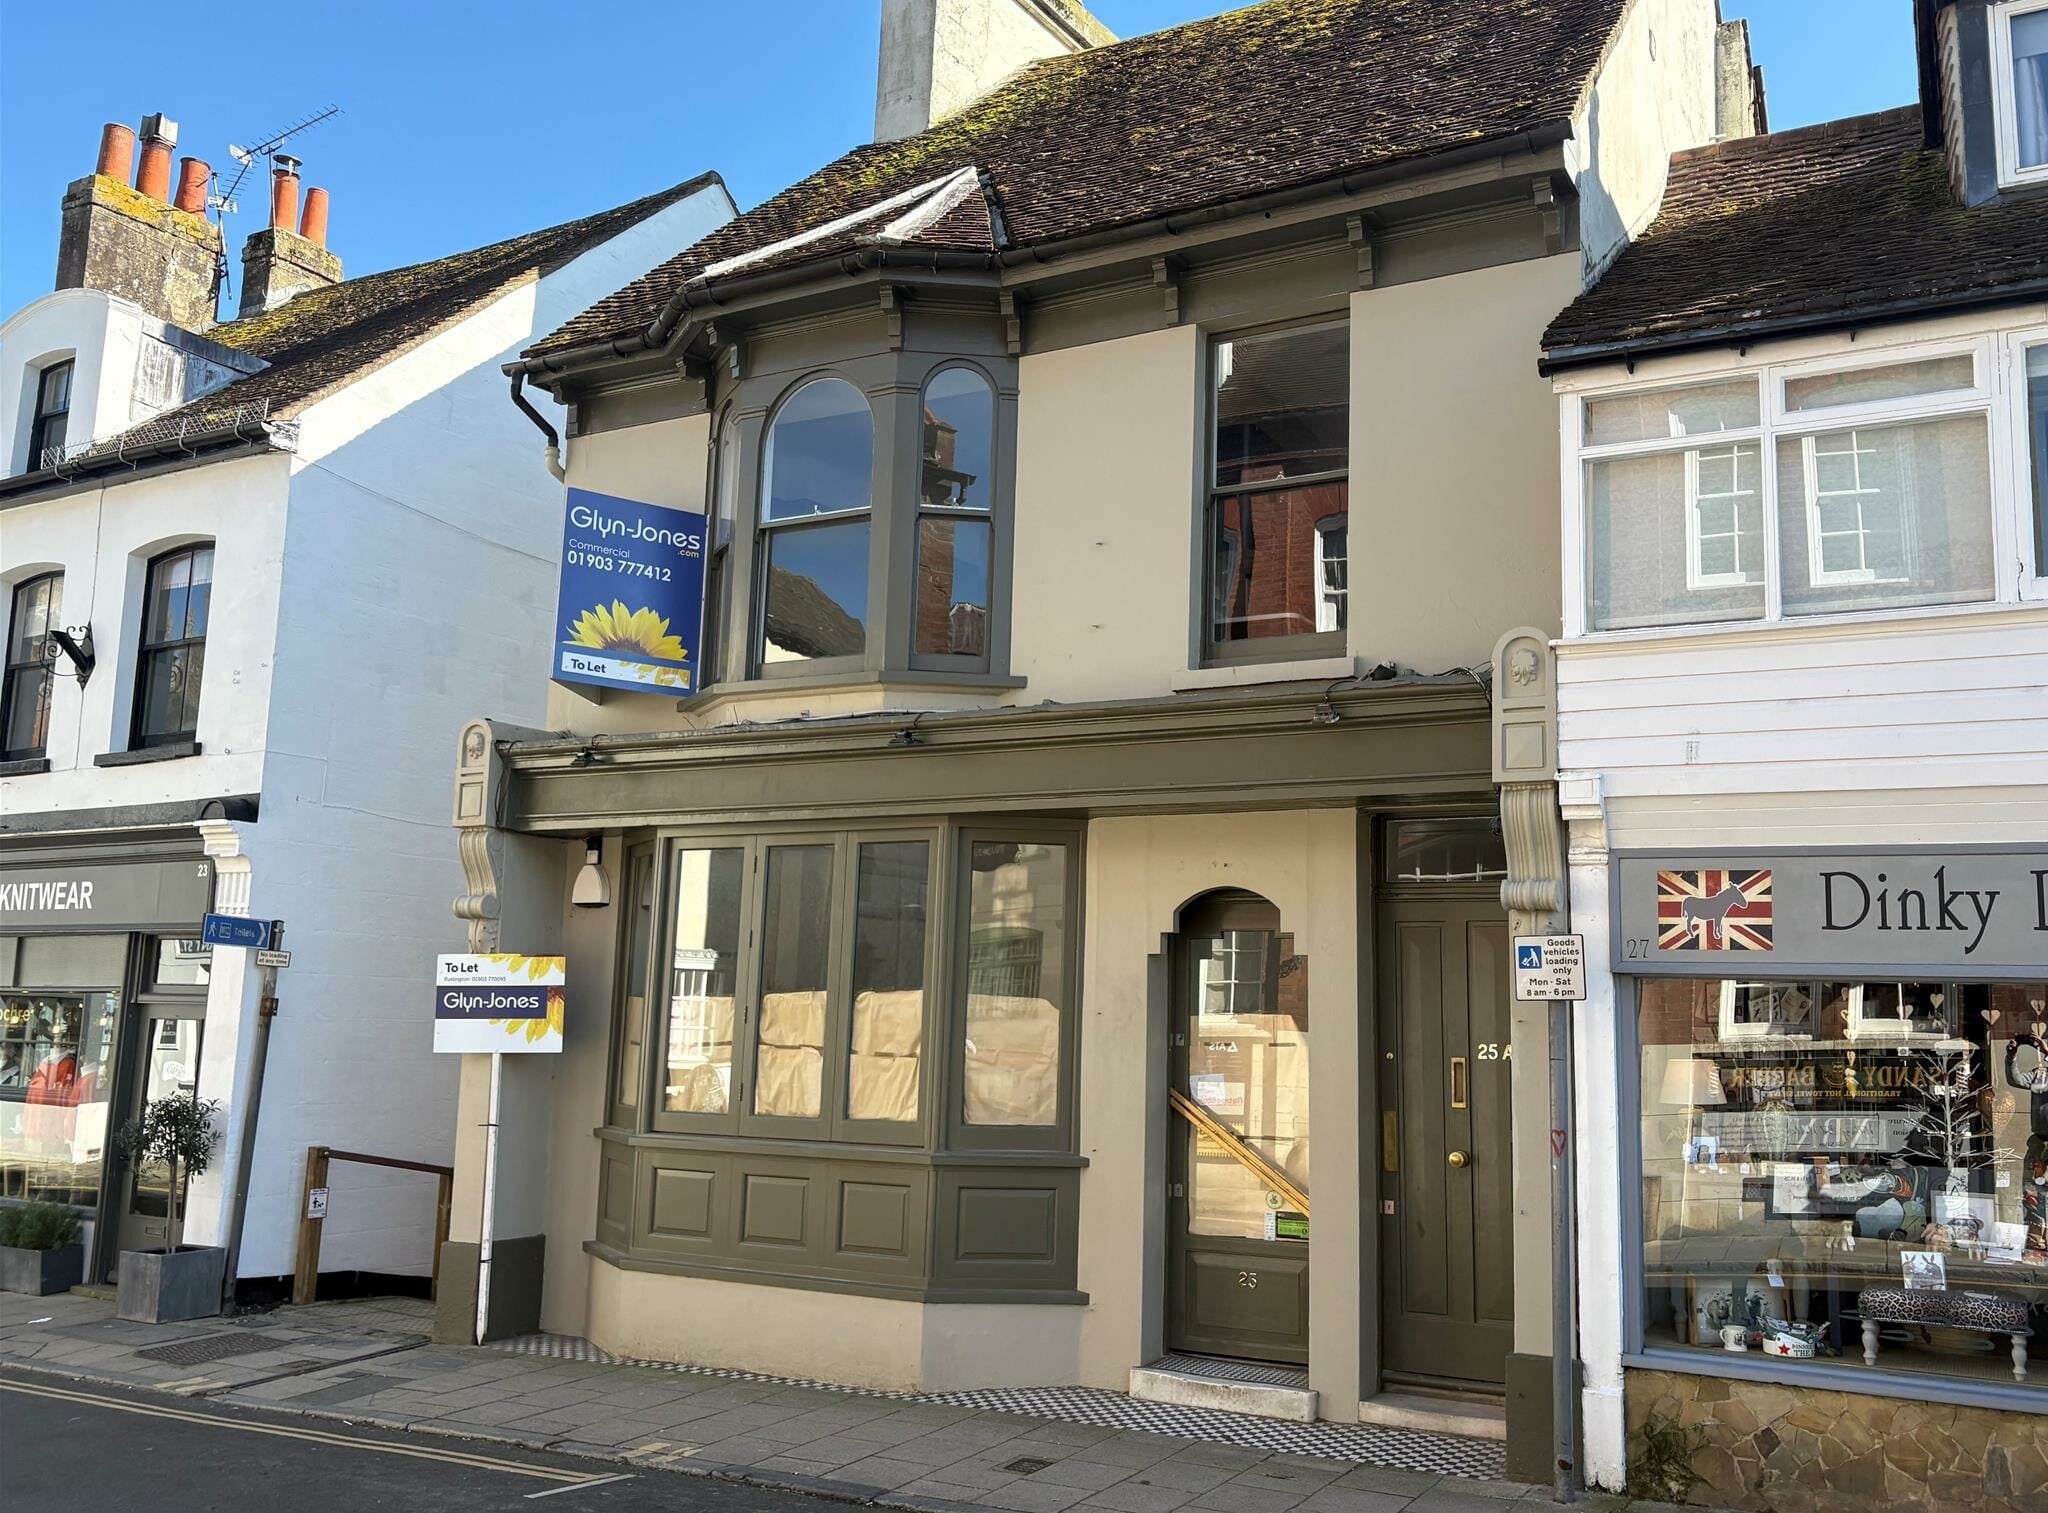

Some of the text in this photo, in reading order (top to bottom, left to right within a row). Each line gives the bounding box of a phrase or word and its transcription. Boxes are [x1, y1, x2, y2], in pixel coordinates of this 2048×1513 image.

[570, 505, 701, 550] Glyn-Jones
[568, 538, 630, 559] Commercial
[678, 548, 700, 559] .com
[567, 549, 672, 582] 01903 777412
[570, 658, 606, 674] To Let
[197, 864, 208, 877] 23
[0, 881, 94, 911] KNITWEAR
[1819, 864, 2001, 955] Dinky
[233, 927, 256, 938] Toilets
[1547, 938, 1575, 946] Goods
[1626, 938, 1650, 959] 27
[445, 962, 479, 973] To Let
[1545, 958, 1579, 966] loading
[1552, 967, 1572, 975] only
[1529, 978, 1549, 986] Mon
[1555, 977, 1571, 986] Sat
[1553, 988, 1559, 996] 6
[1561, 989, 1576, 997] pm
[443, 992, 539, 1013] Glyn-Jones
[1477, 1043, 1512, 1060] 25 A
[1238, 1271, 1257, 1289] 25
